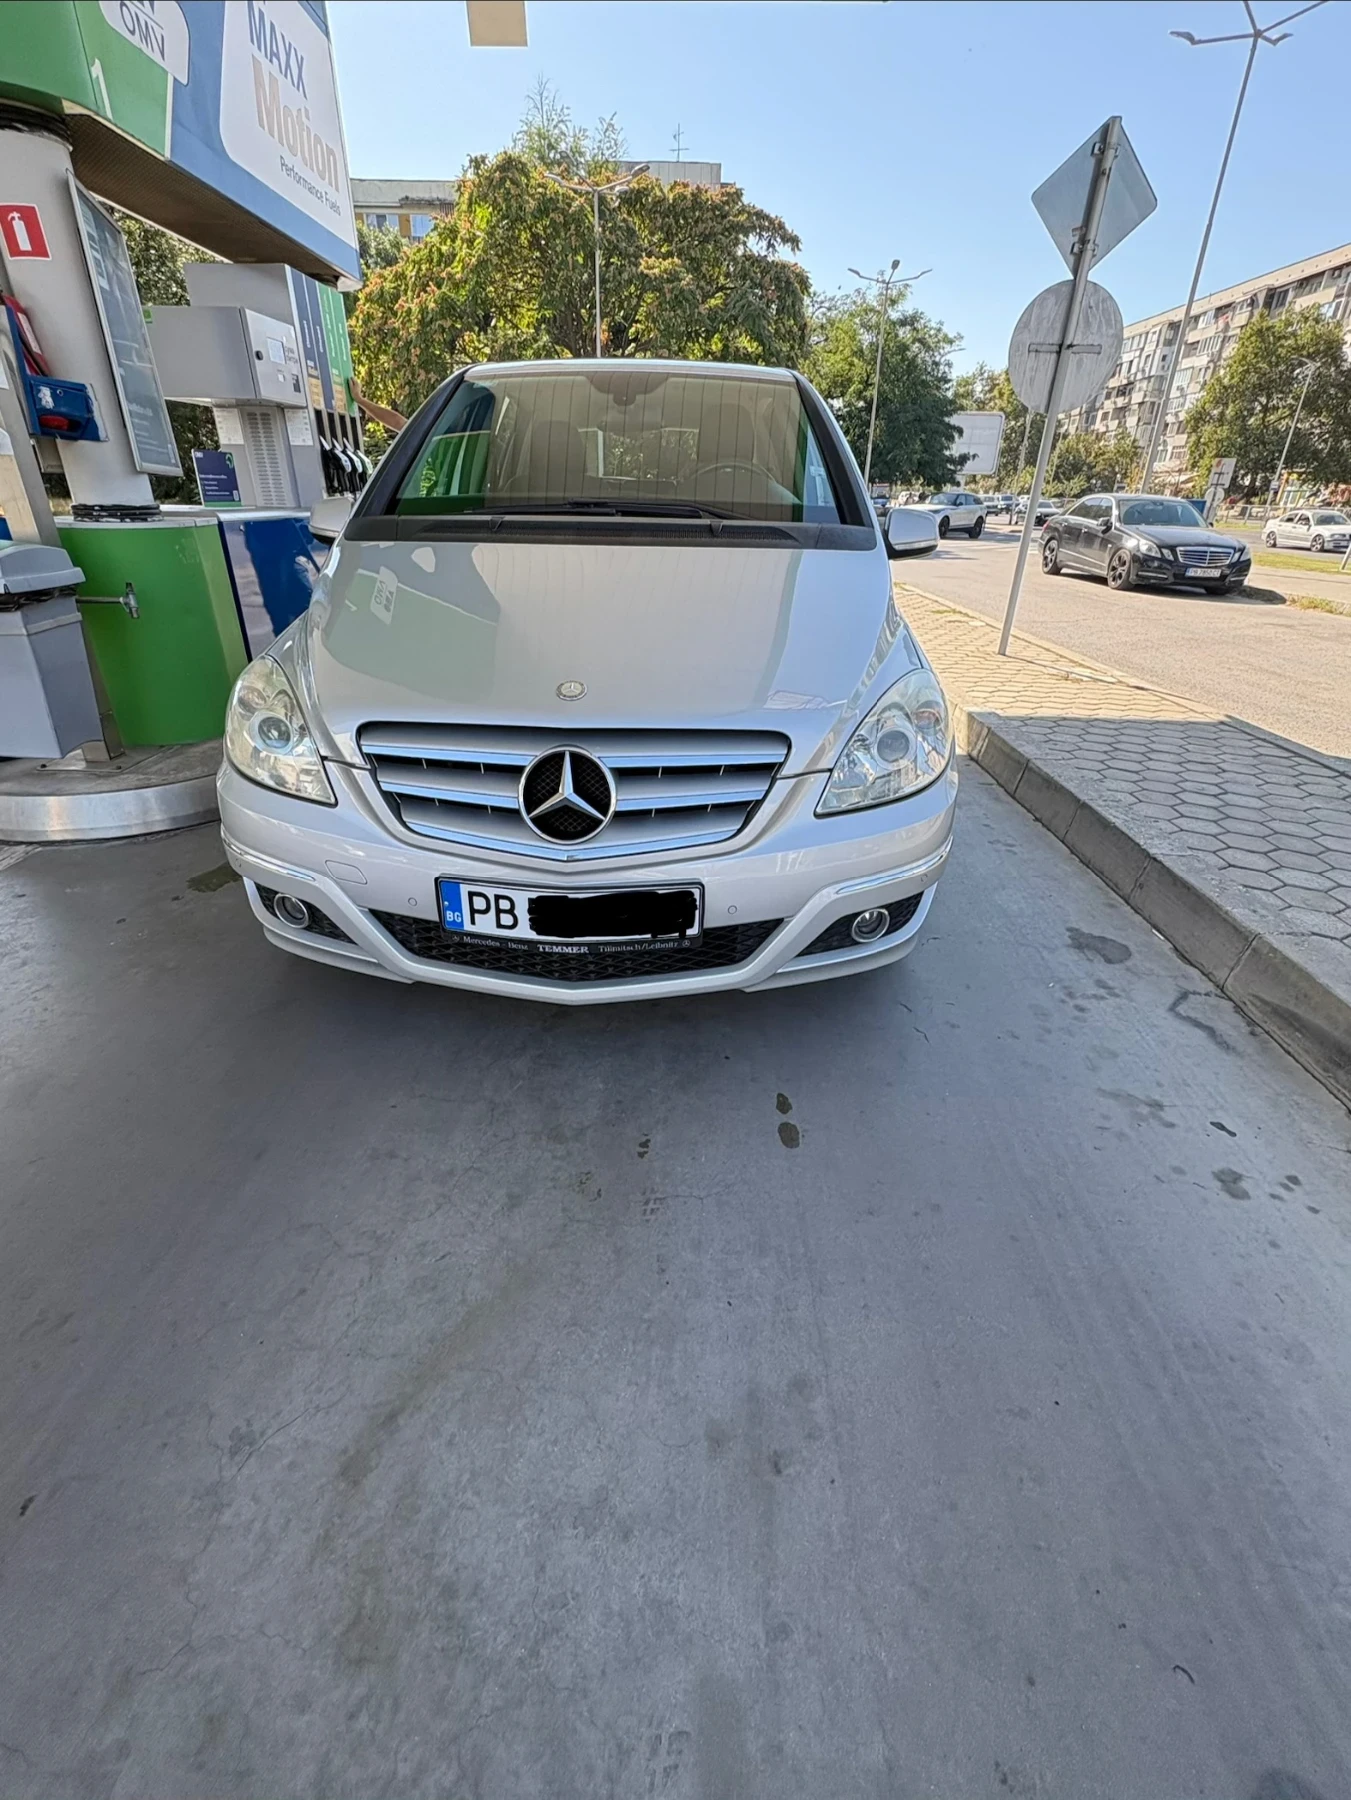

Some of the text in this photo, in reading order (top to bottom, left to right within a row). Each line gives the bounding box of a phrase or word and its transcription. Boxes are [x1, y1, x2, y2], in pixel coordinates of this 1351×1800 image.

[120, 1, 165, 62] OMV
[247, 1, 308, 101] MAXX
[252, 54, 340, 193] Motion
[280, 155, 341, 217] Performance Fuels
[446, 911, 461, 922] BG
[467, 890, 518, 930] PB
[463, 936, 500, 947] Mercedes
[508, 942, 528, 950] Benz
[536, 944, 589, 954] TEMMER
